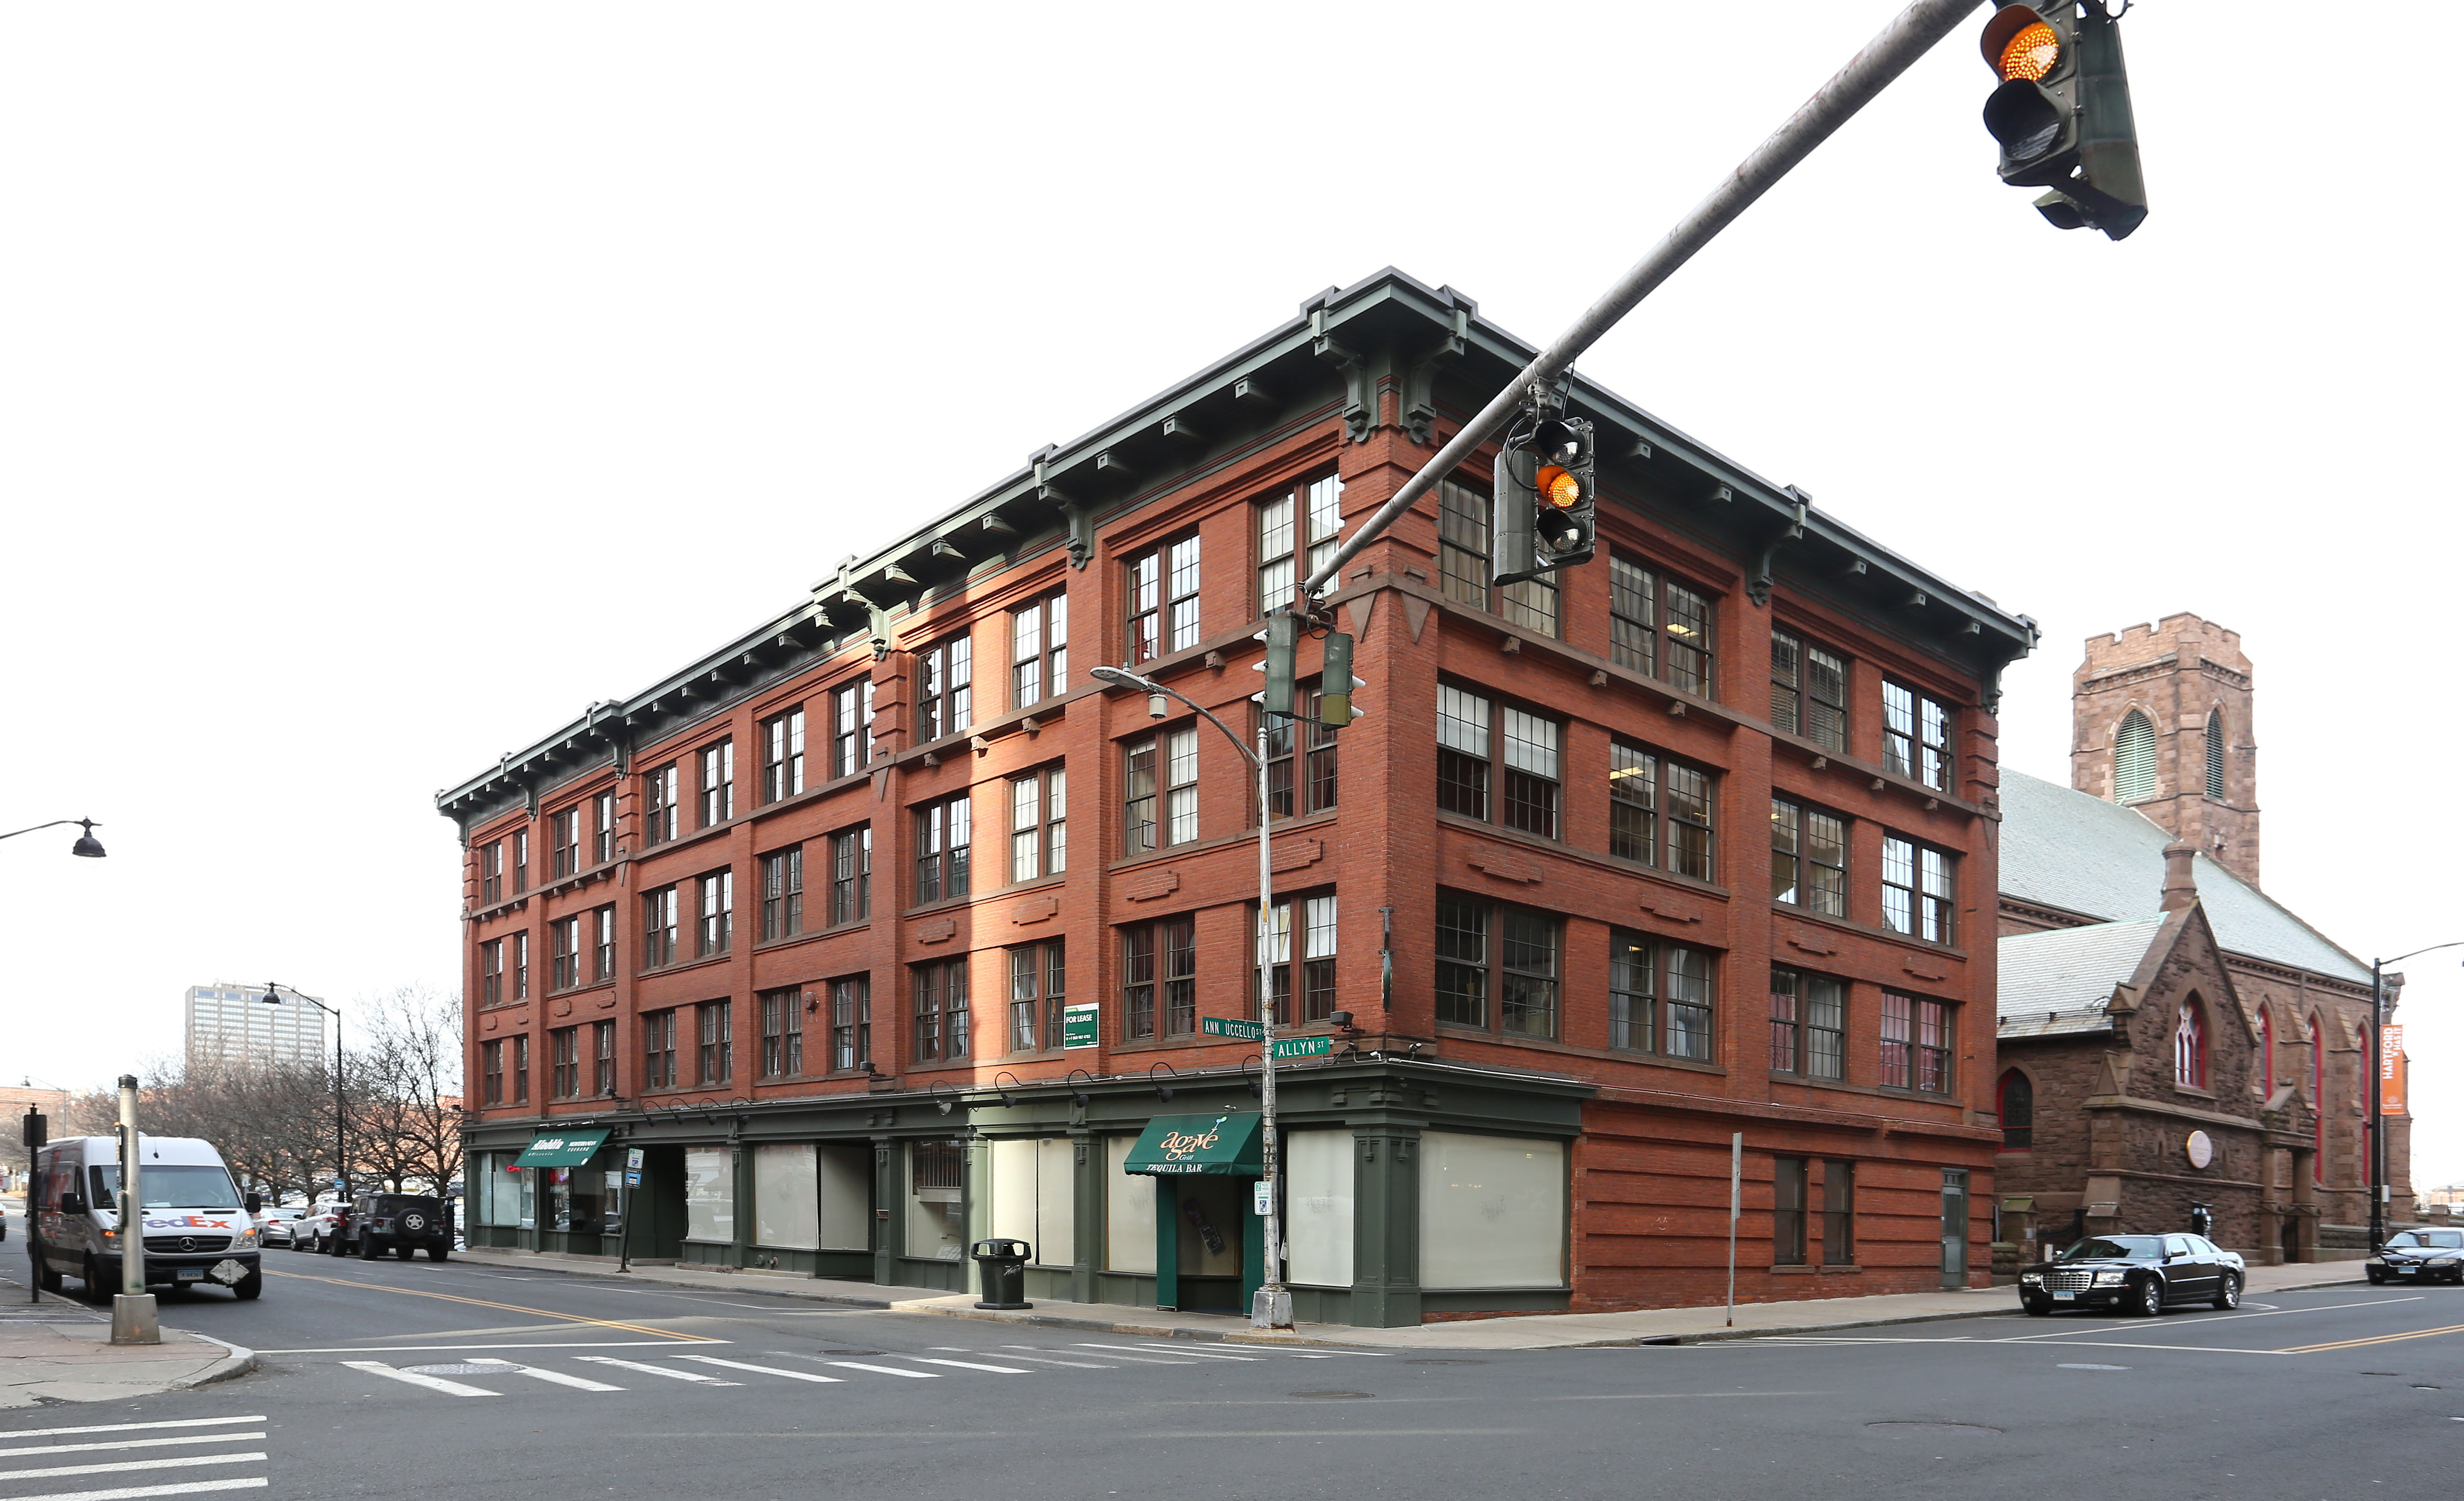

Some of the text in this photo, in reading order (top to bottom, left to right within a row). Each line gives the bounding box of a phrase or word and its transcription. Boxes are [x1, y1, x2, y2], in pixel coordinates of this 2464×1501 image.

[1205, 1020, 1219, 1034] ANN
[1225, 1023, 1256, 1039] UCCELLO
[1278, 1041, 1315, 1057] ALLYN
[2393, 1036, 2401, 1050] HAS
[2382, 1027, 2394, 1079] HARTFORD
[1160, 1128, 1219, 1161] agave
[1145, 1164, 1202, 1173] TEQUILA BAR
